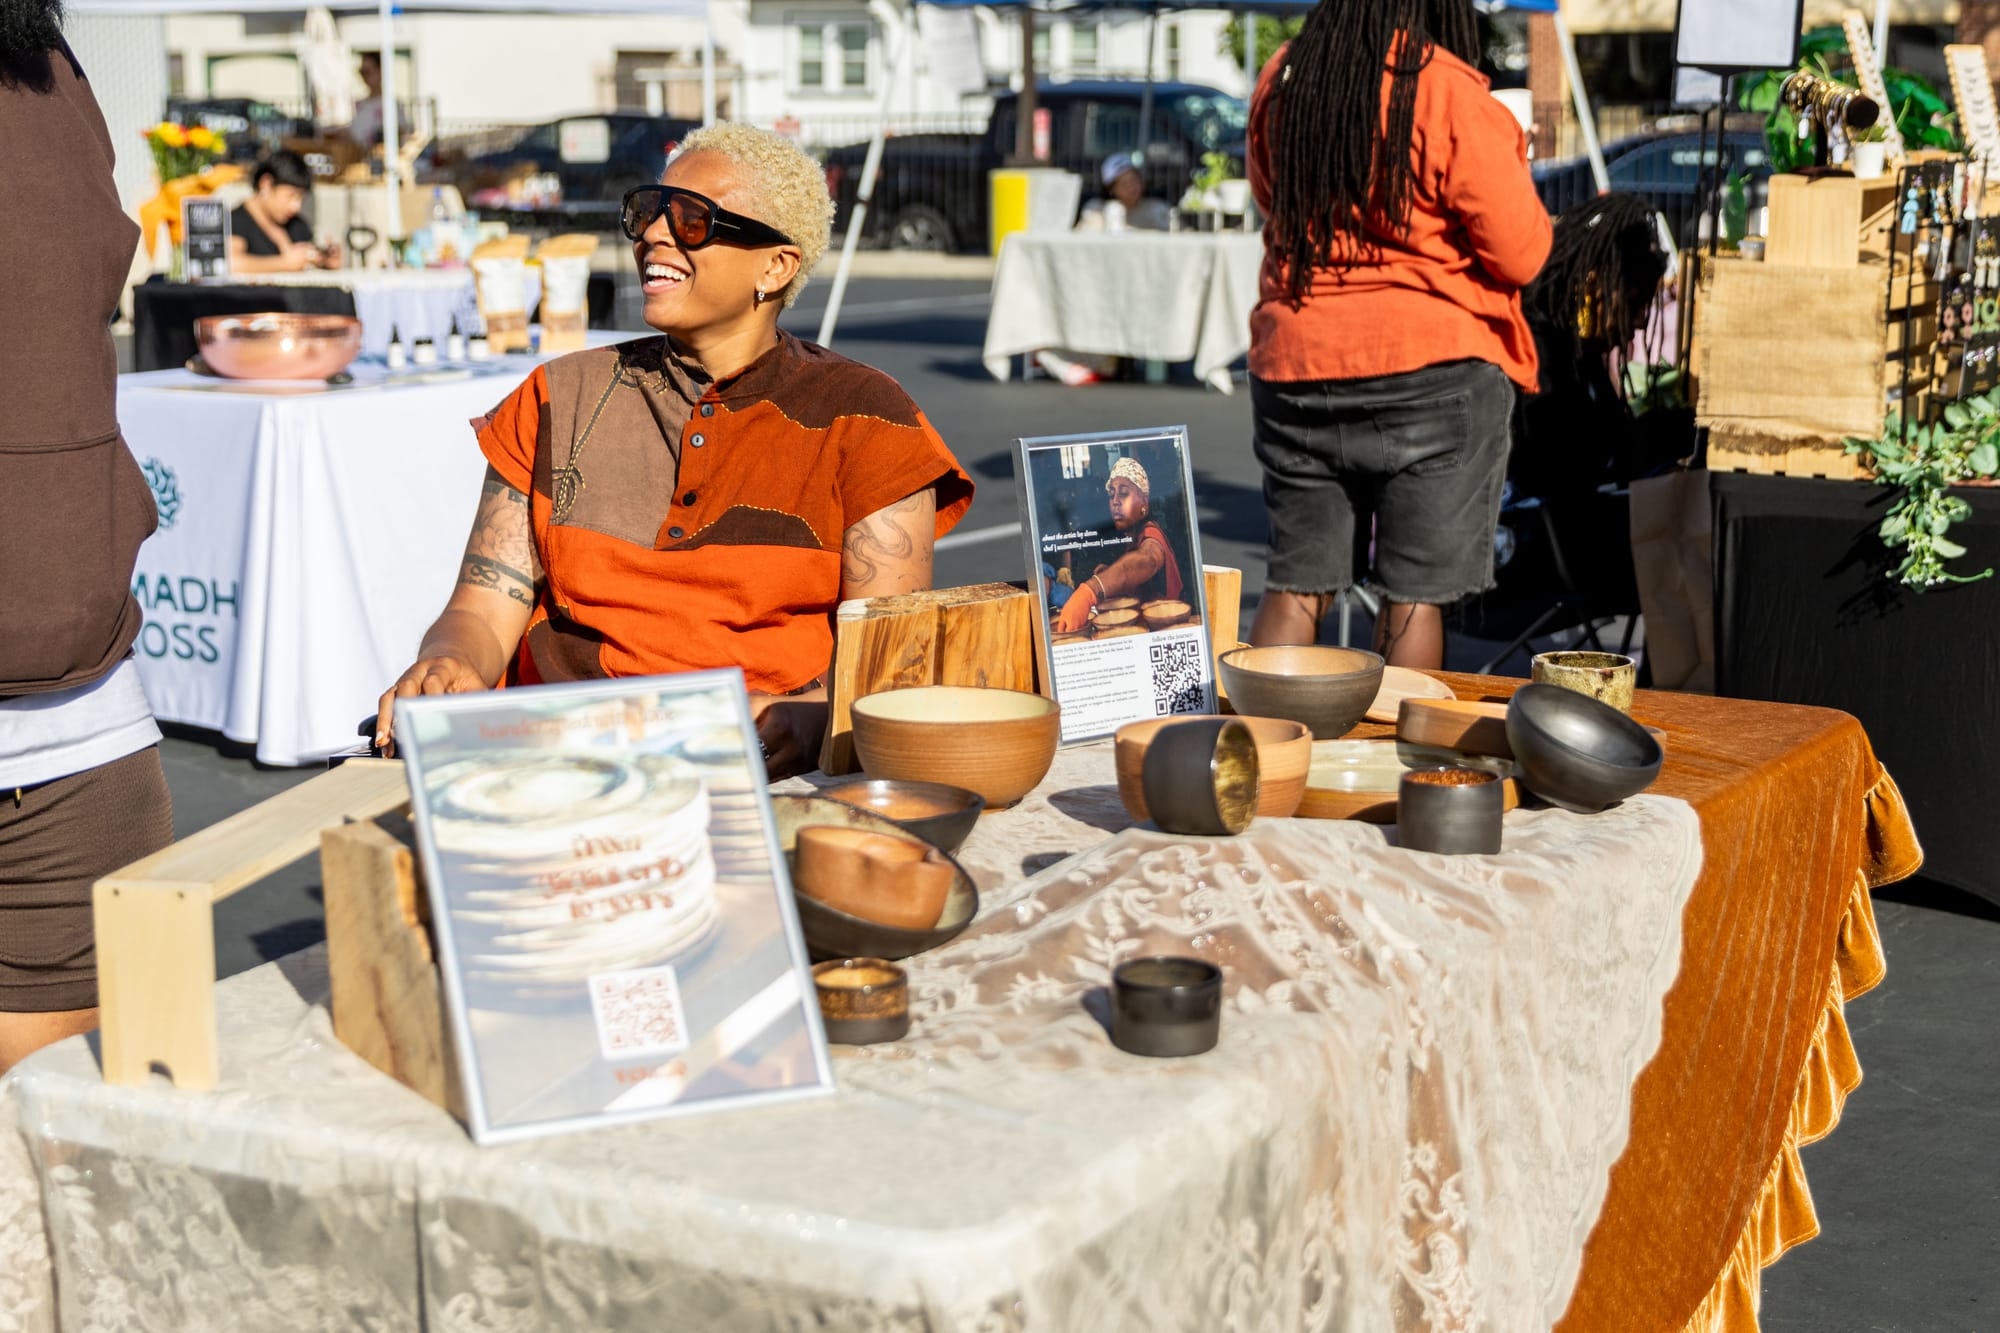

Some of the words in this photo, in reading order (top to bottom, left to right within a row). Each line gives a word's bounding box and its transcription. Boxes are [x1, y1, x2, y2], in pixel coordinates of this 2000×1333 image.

[1077, 531, 1084, 539] by
[1043, 544, 1054, 552] chef
[1167, 633, 1175, 641] the
[134, 620, 219, 663] OSS
